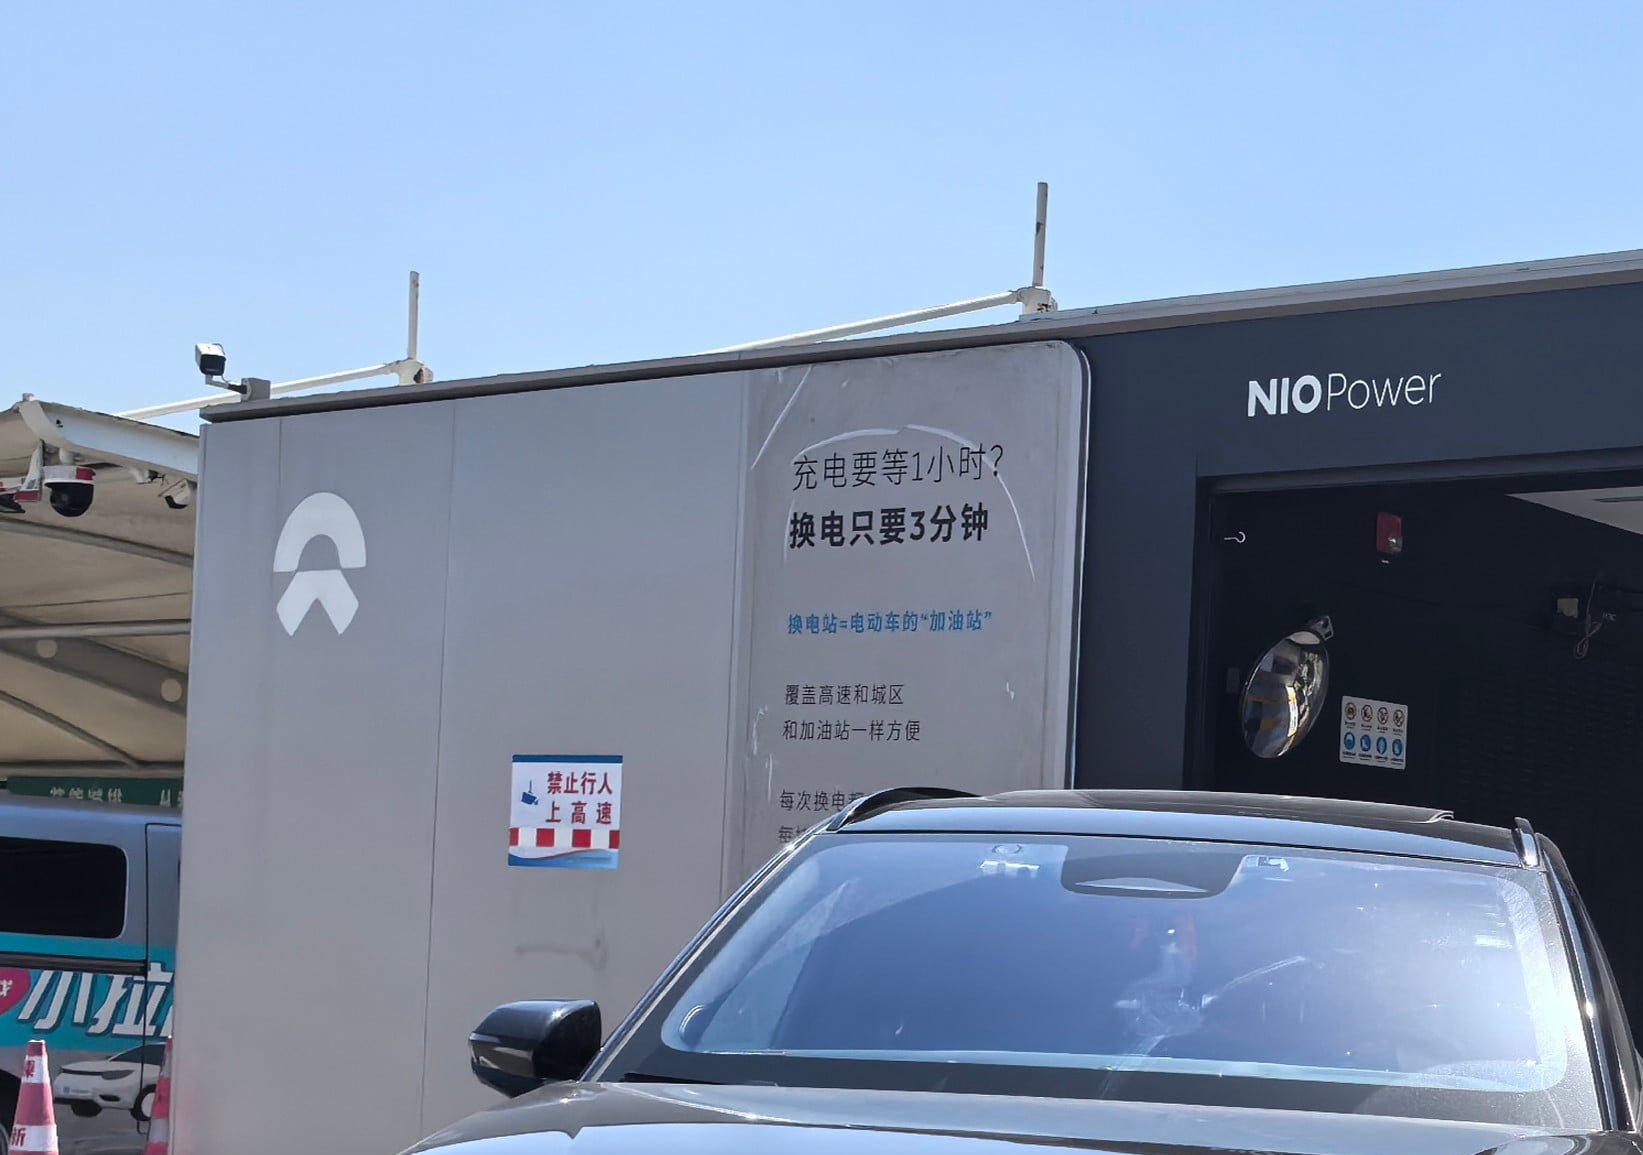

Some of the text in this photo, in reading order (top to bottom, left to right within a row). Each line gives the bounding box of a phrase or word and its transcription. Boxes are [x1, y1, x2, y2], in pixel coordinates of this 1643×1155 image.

[792, 444, 1004, 492] 充电要等1小时?
[789, 502, 989, 549] 换电只要3分钟
[787, 610, 993, 635] 换电站=电动车的“加油站”
[784, 683, 905, 706] 覆盖高速和城区
[782, 720, 921, 742] 和加油站一样方便
[546, 771, 613, 795] 禁止行人
[545, 800, 613, 825] 上高速
[17, 962, 174, 1038] 小拉
